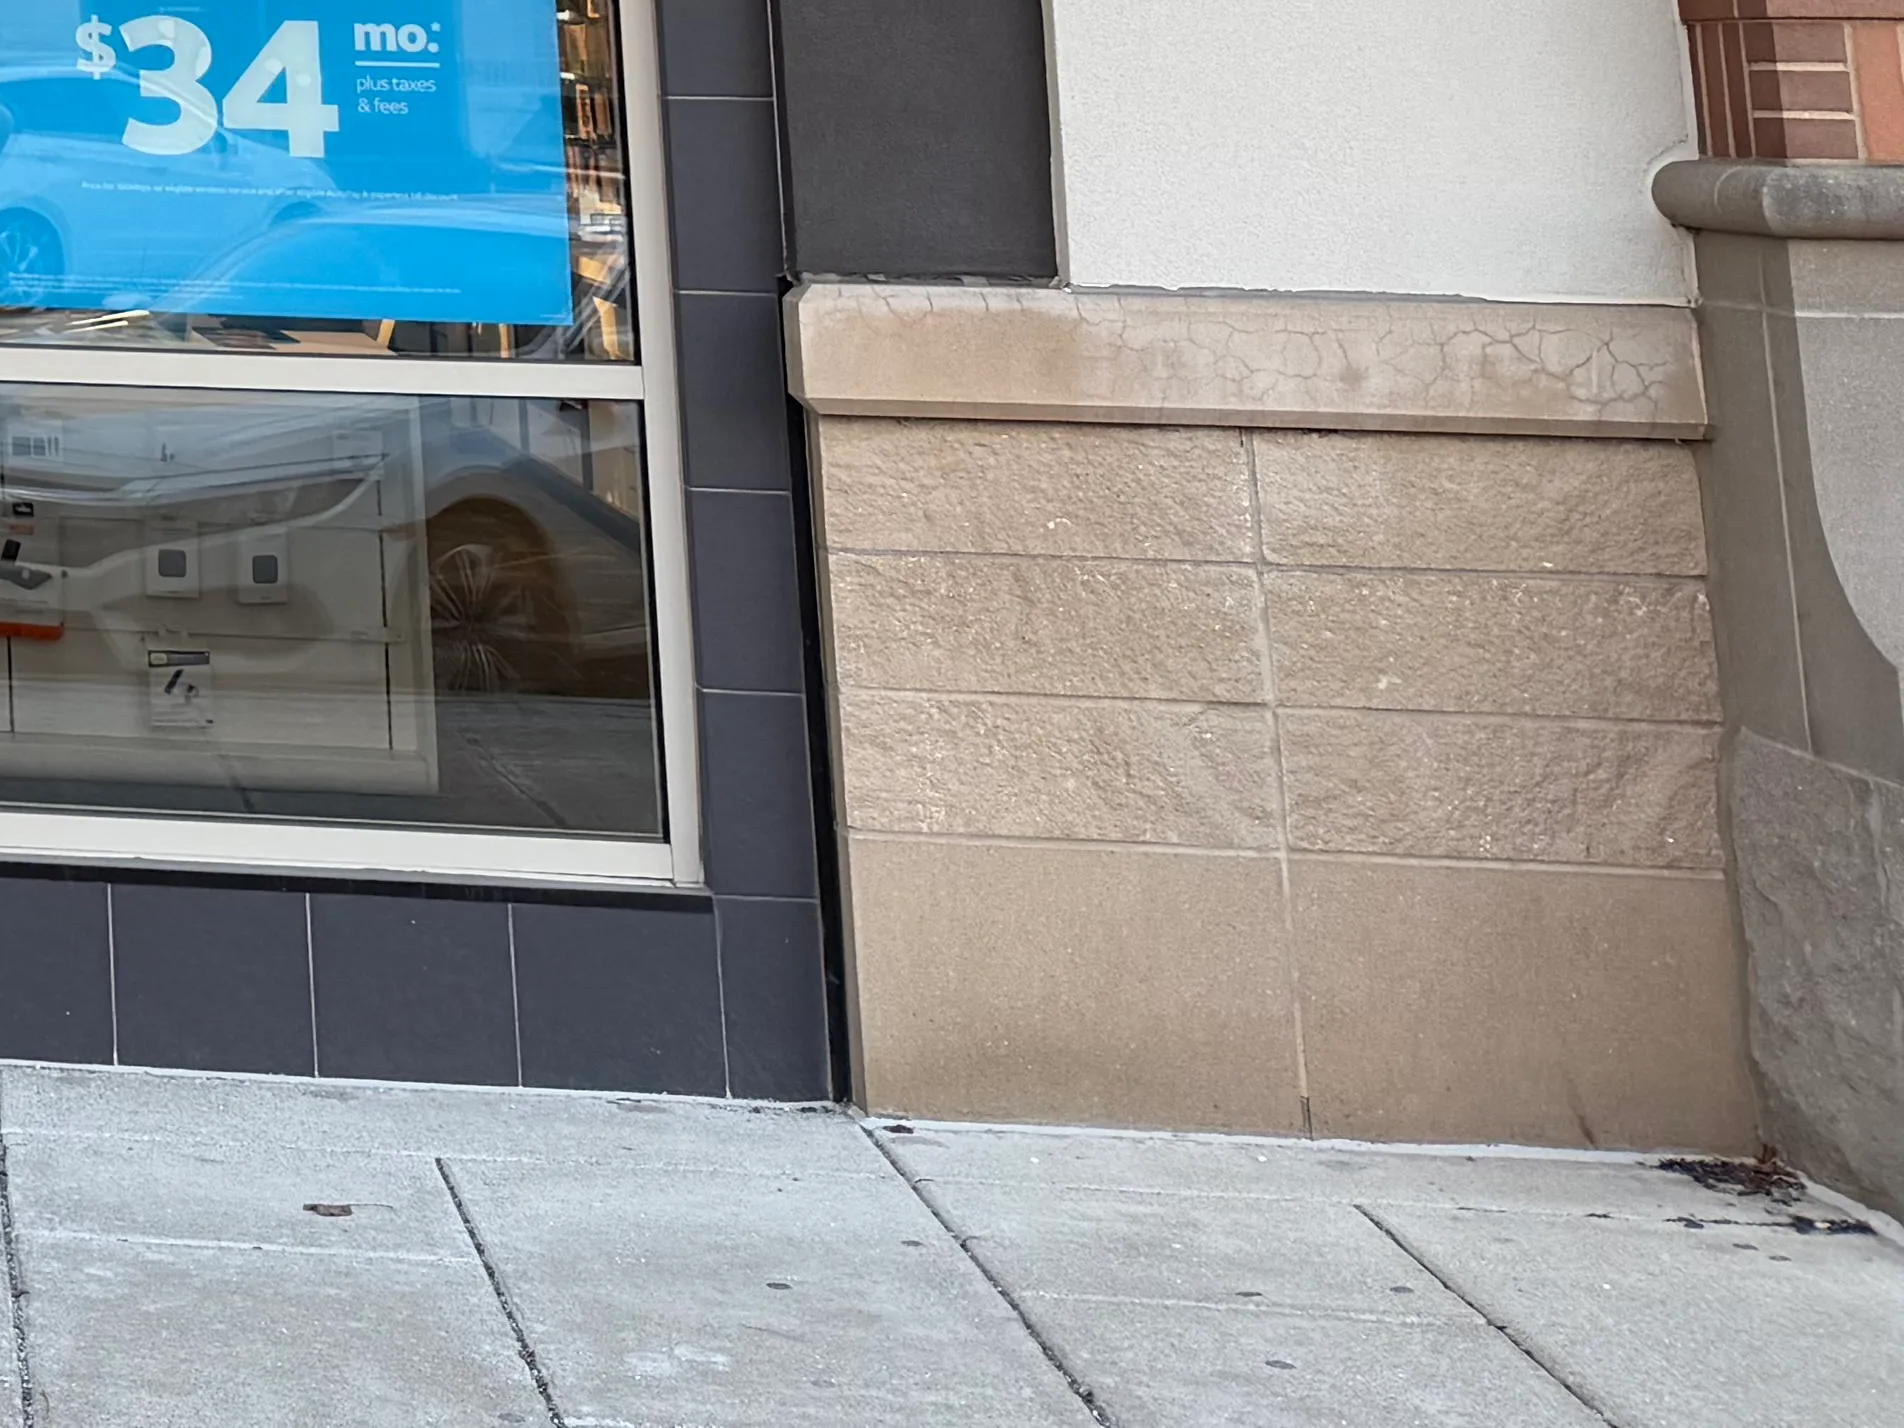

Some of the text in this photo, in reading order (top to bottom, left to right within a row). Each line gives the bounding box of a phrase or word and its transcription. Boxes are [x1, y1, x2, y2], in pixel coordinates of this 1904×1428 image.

[356, 74, 437, 94] plus taxes
[357, 97, 409, 114] & fees
